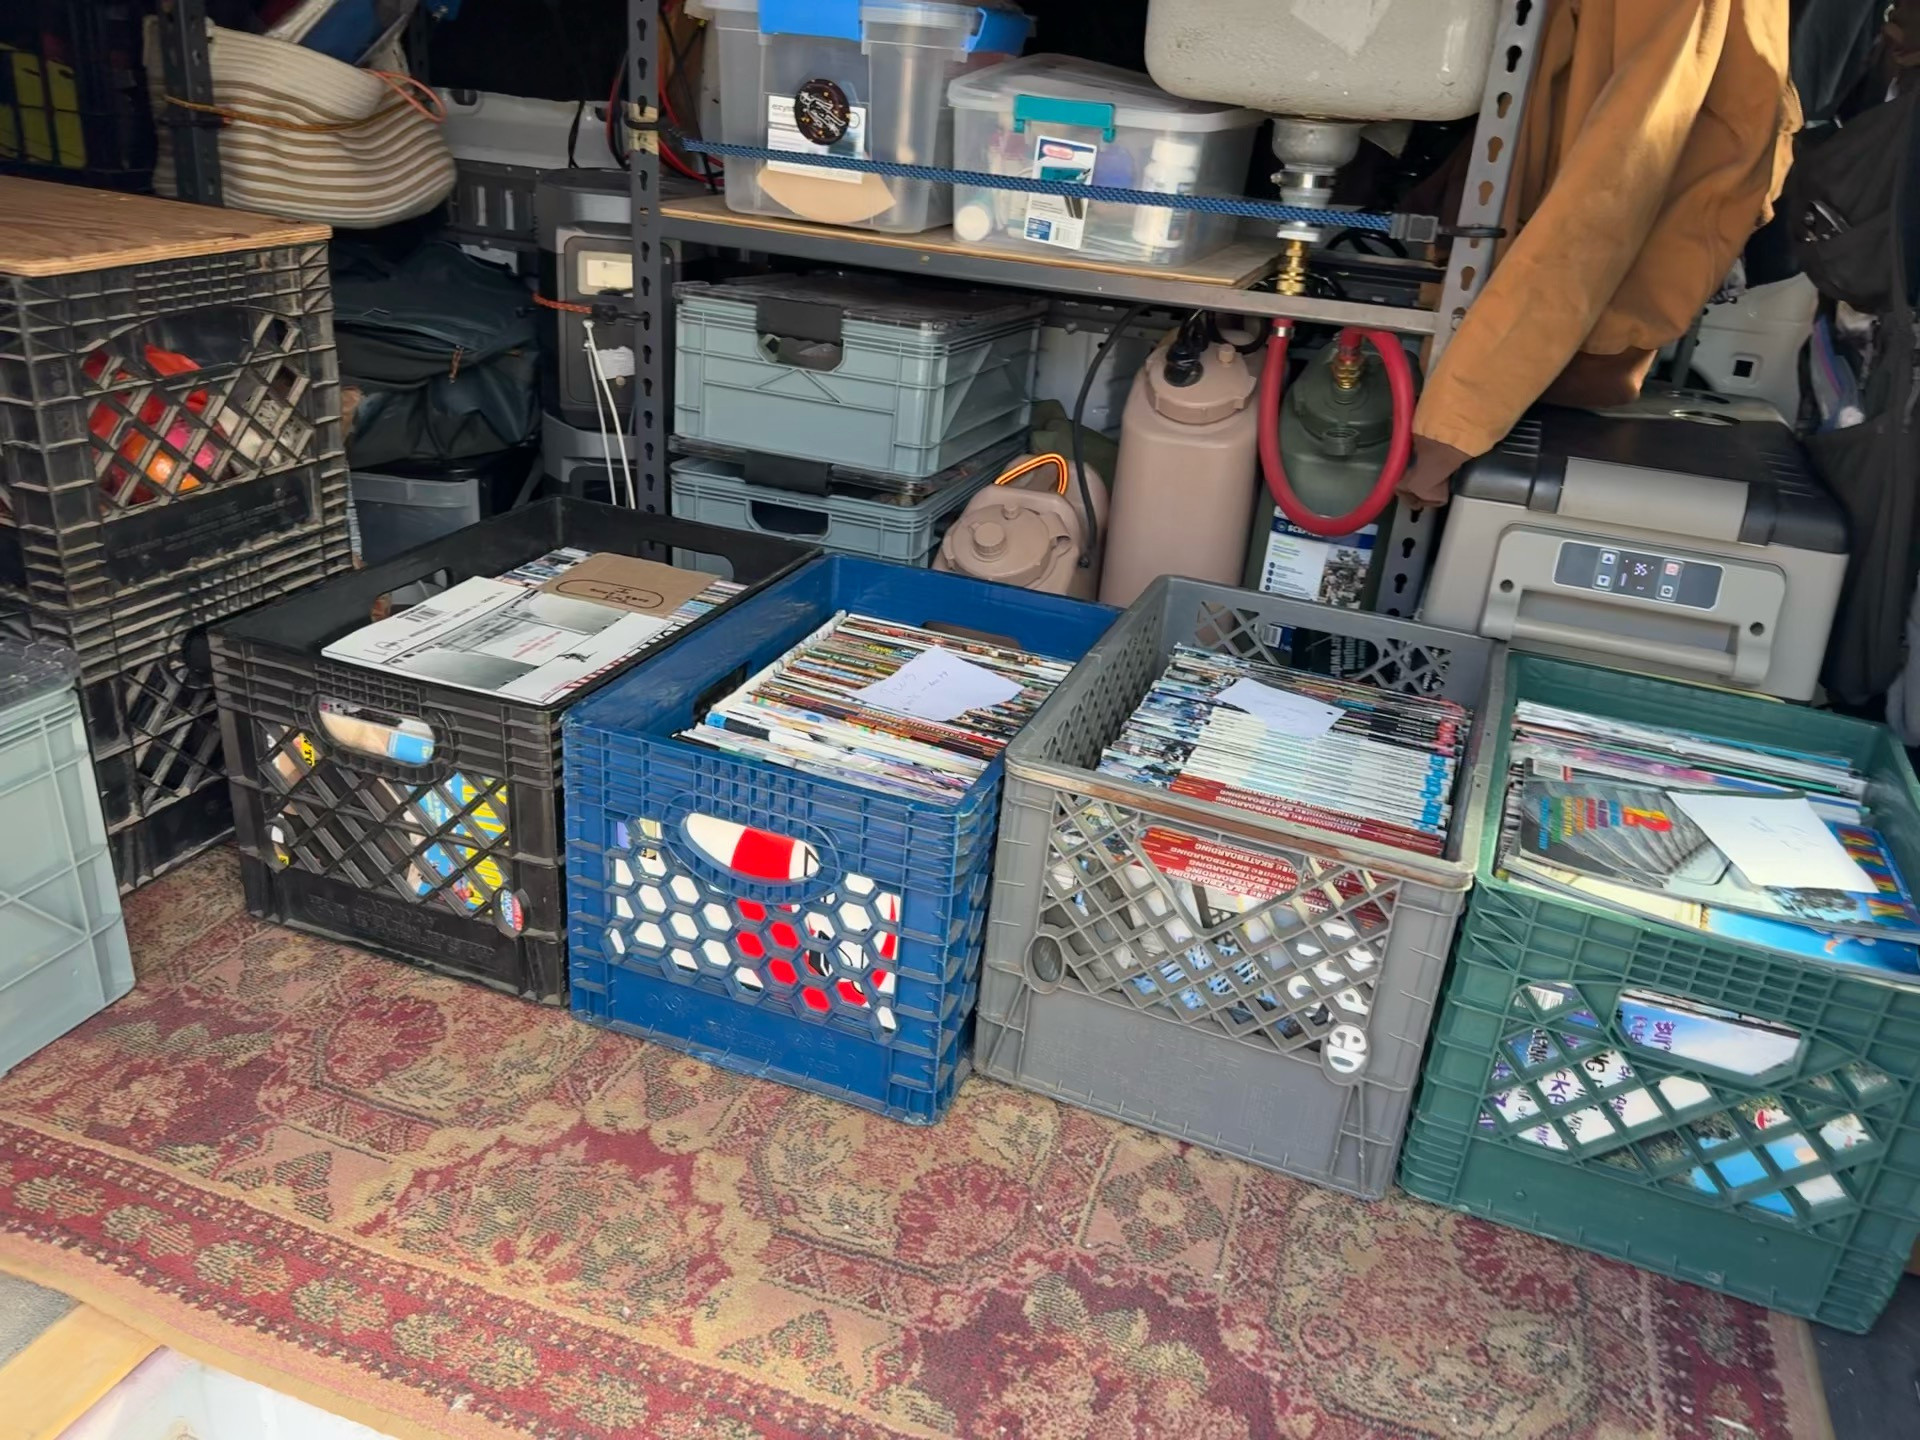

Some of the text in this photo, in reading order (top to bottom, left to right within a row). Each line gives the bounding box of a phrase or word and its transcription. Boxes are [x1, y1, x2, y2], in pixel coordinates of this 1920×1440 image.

[1169, 846, 1251, 873] SKATEBOARDING
[1194, 842, 1275, 870] SKATEBOARDING
[1165, 867, 1249, 895] SKATEBOARDING
[1184, 865, 1268, 892] SKATEBOARDING
[1188, 858, 1271, 885] SKATEBOARDING
